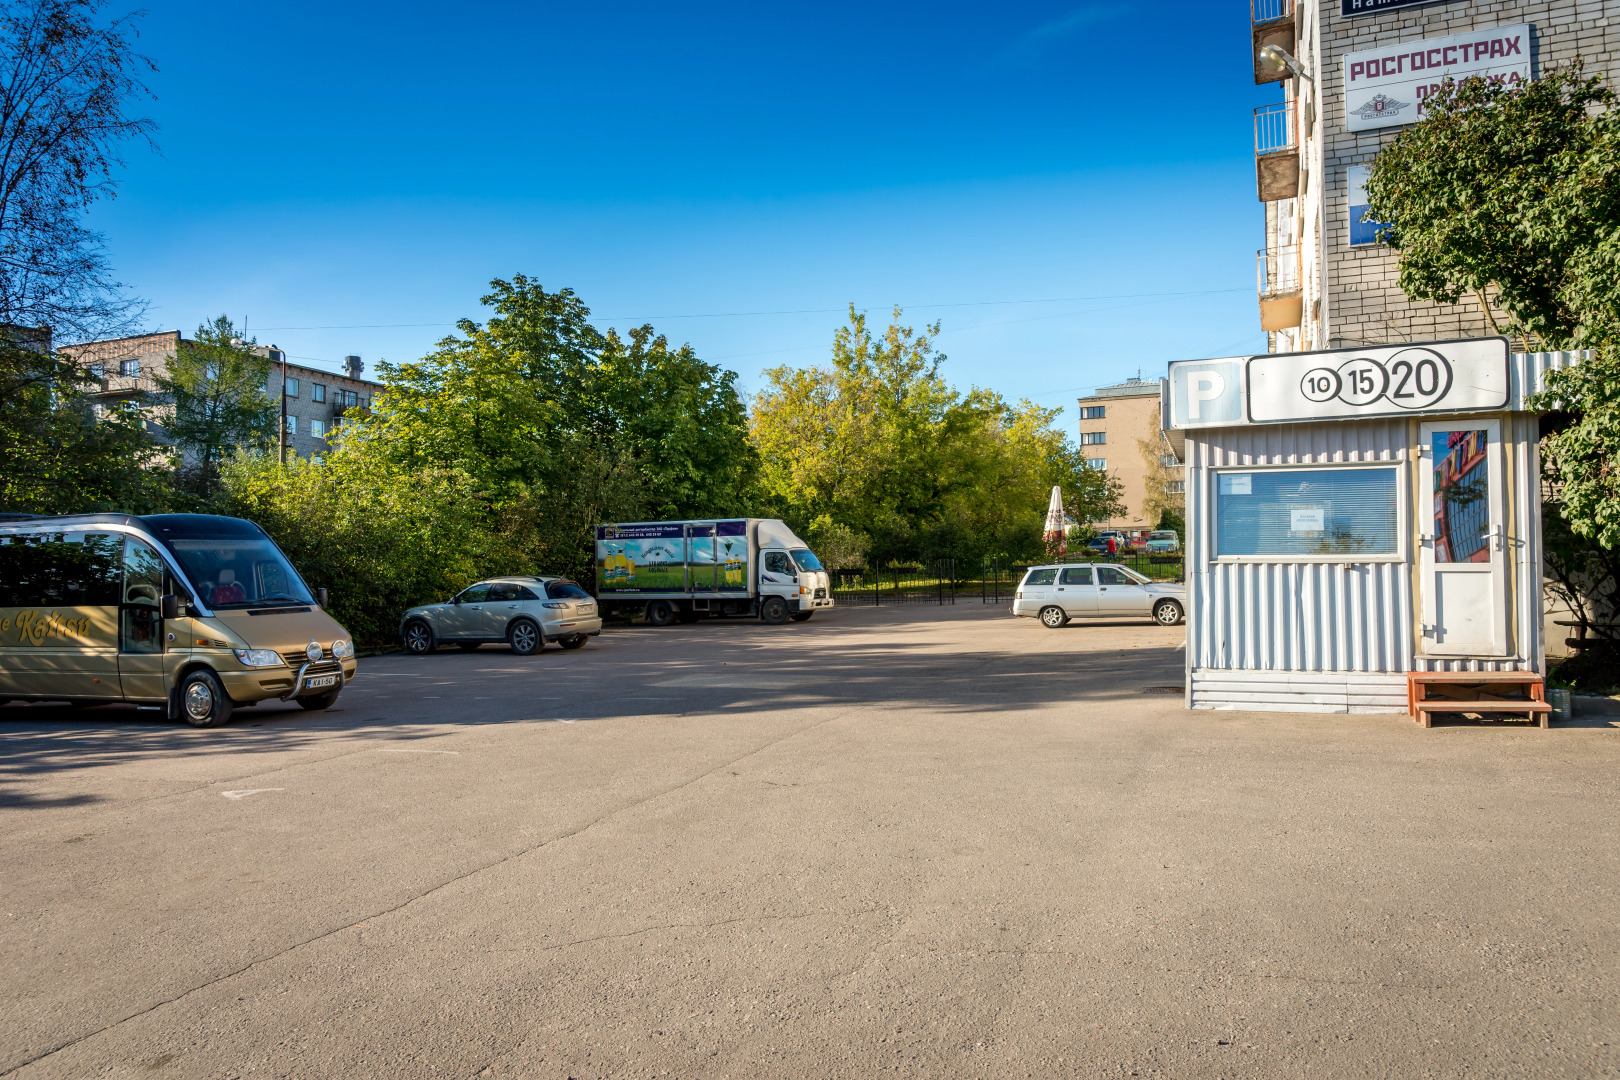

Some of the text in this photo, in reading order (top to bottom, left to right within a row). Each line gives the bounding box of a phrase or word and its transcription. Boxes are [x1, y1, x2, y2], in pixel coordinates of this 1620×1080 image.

[1350, 36, 1521, 81] РОСГОССТРАХ
[1308, 359, 1439, 398] 10 15 20
[16, 610, 91, 647] Kaitsu
